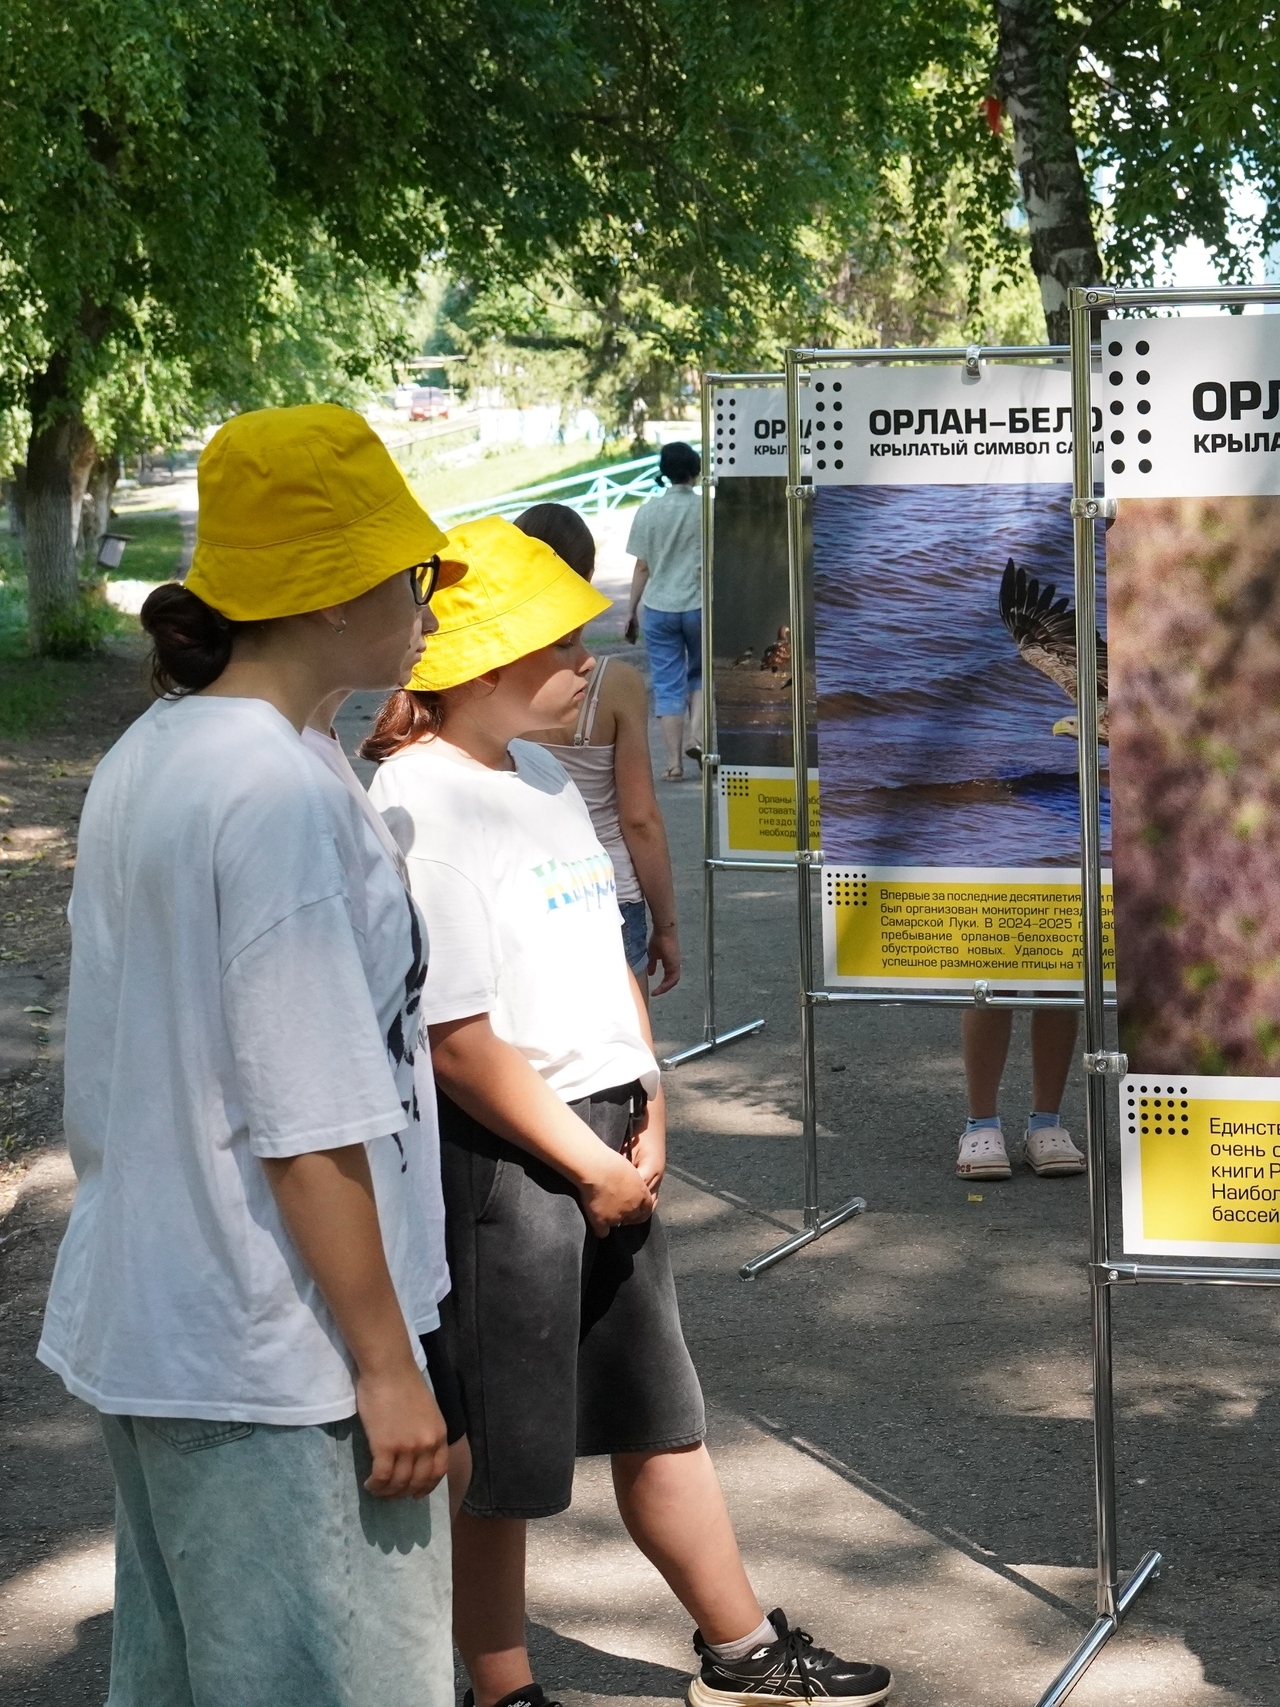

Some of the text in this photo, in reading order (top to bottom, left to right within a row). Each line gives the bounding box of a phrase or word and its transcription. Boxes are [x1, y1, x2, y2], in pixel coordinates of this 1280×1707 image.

[870, 439, 968, 456] КРЫЛАТЫЙ
[974, 442, 1050, 455] СИМВОЛ
[880, 888, 930, 902] Впервые
[932, 892, 945, 900] за
[947, 893, 1007, 903] последние
[1009, 893, 1082, 903] десятилетия
[880, 903, 902, 914] был
[905, 905, 978, 916] организован
[982, 907, 1050, 917] мониторинг
[880, 915, 944, 929] Самарской
[949, 917, 979, 930] Луки.
[985, 918, 993, 928] В
[881, 930, 953, 942] пребывание
[881, 943, 959, 956] обустройство
[967, 946, 1005, 955] новых.
[1014, 945, 1064, 957] Удалось
[882, 958, 938, 968] успешное
[940, 959, 1019, 970] размножение
[1021, 961, 1057, 970] птицы
[1210, 1143, 1266, 1157] очень
[1211, 1165, 1264, 1179] книги
